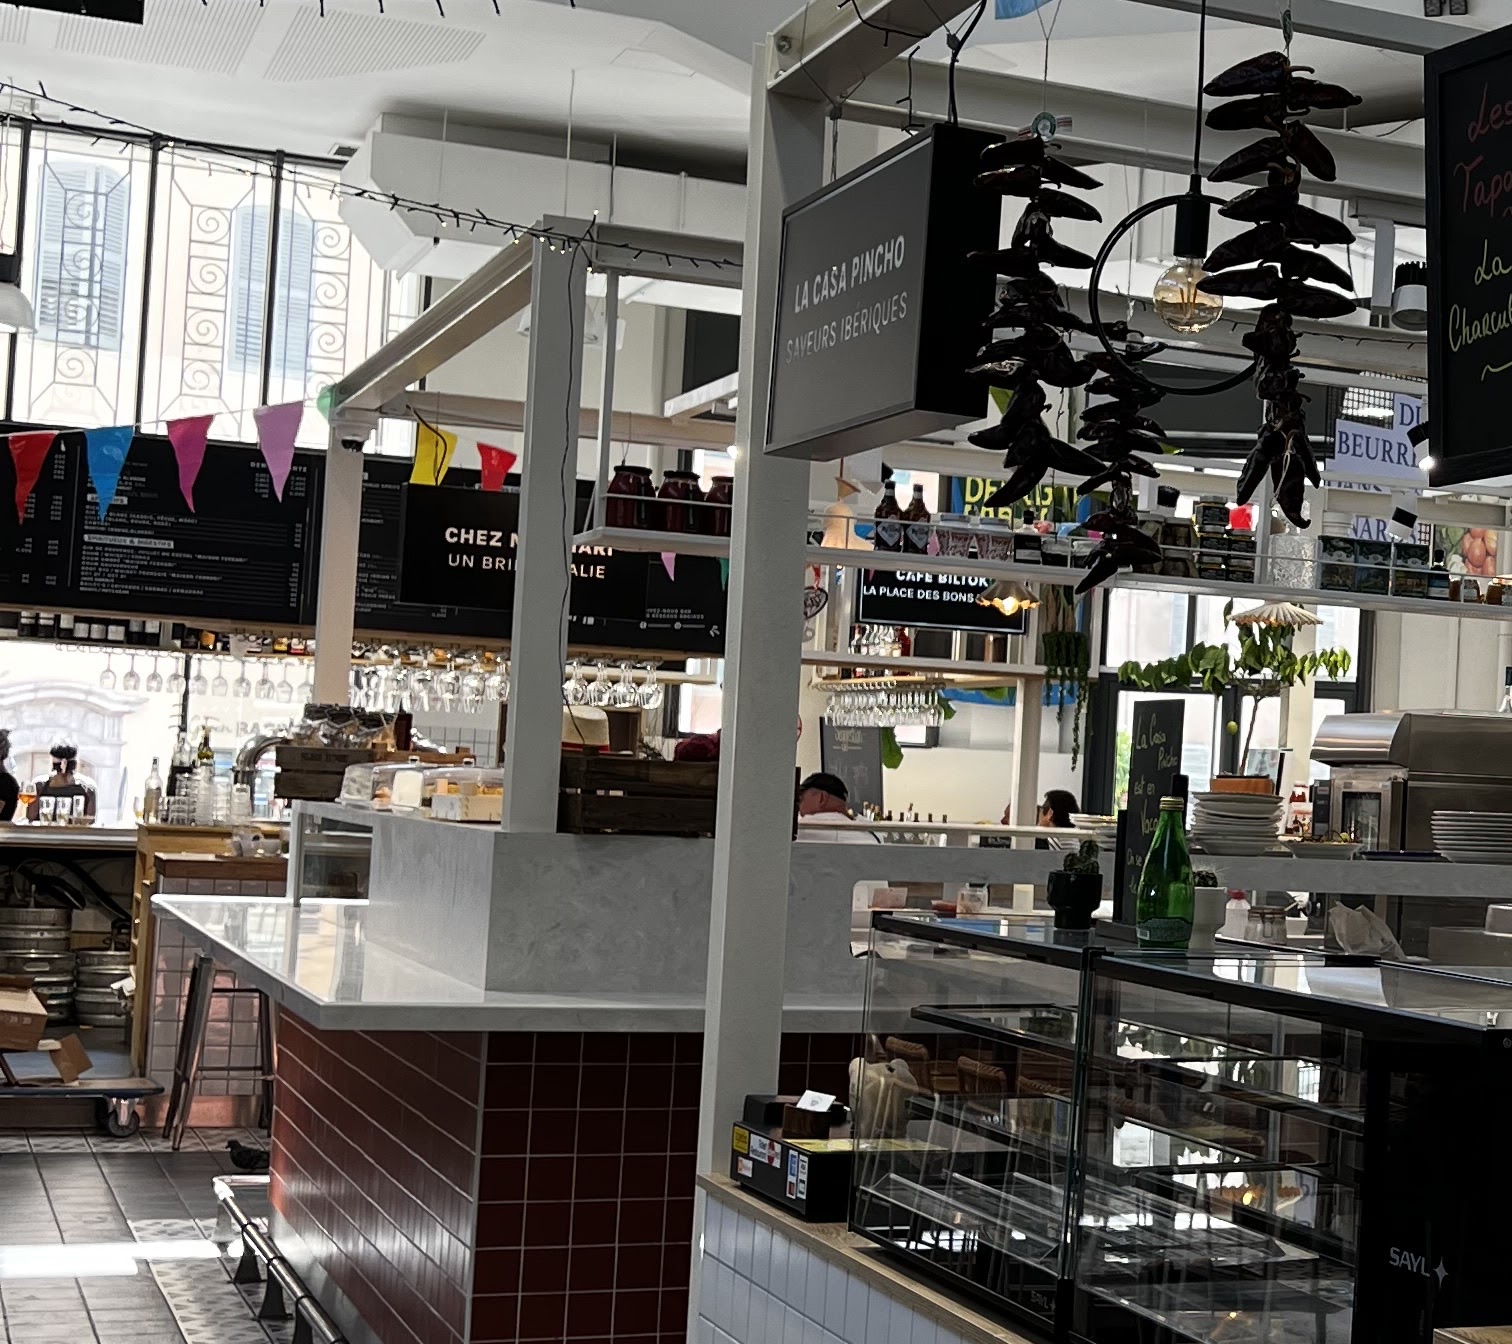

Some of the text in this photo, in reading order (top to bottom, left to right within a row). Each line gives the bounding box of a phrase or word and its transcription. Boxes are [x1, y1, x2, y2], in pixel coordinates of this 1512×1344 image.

[795, 235, 905, 314] LA CASA PINCHO
[1474, 239, 1512, 285] La
[786, 321, 837, 364] SAVEURS
[445, 527, 502, 547] CHEZ
[448, 553, 474, 568] UN
[482, 557, 517, 571] BRI
[863, 585, 974, 603] LA PLACE DES BONS
[1389, 1247, 1430, 1277] SAYL
